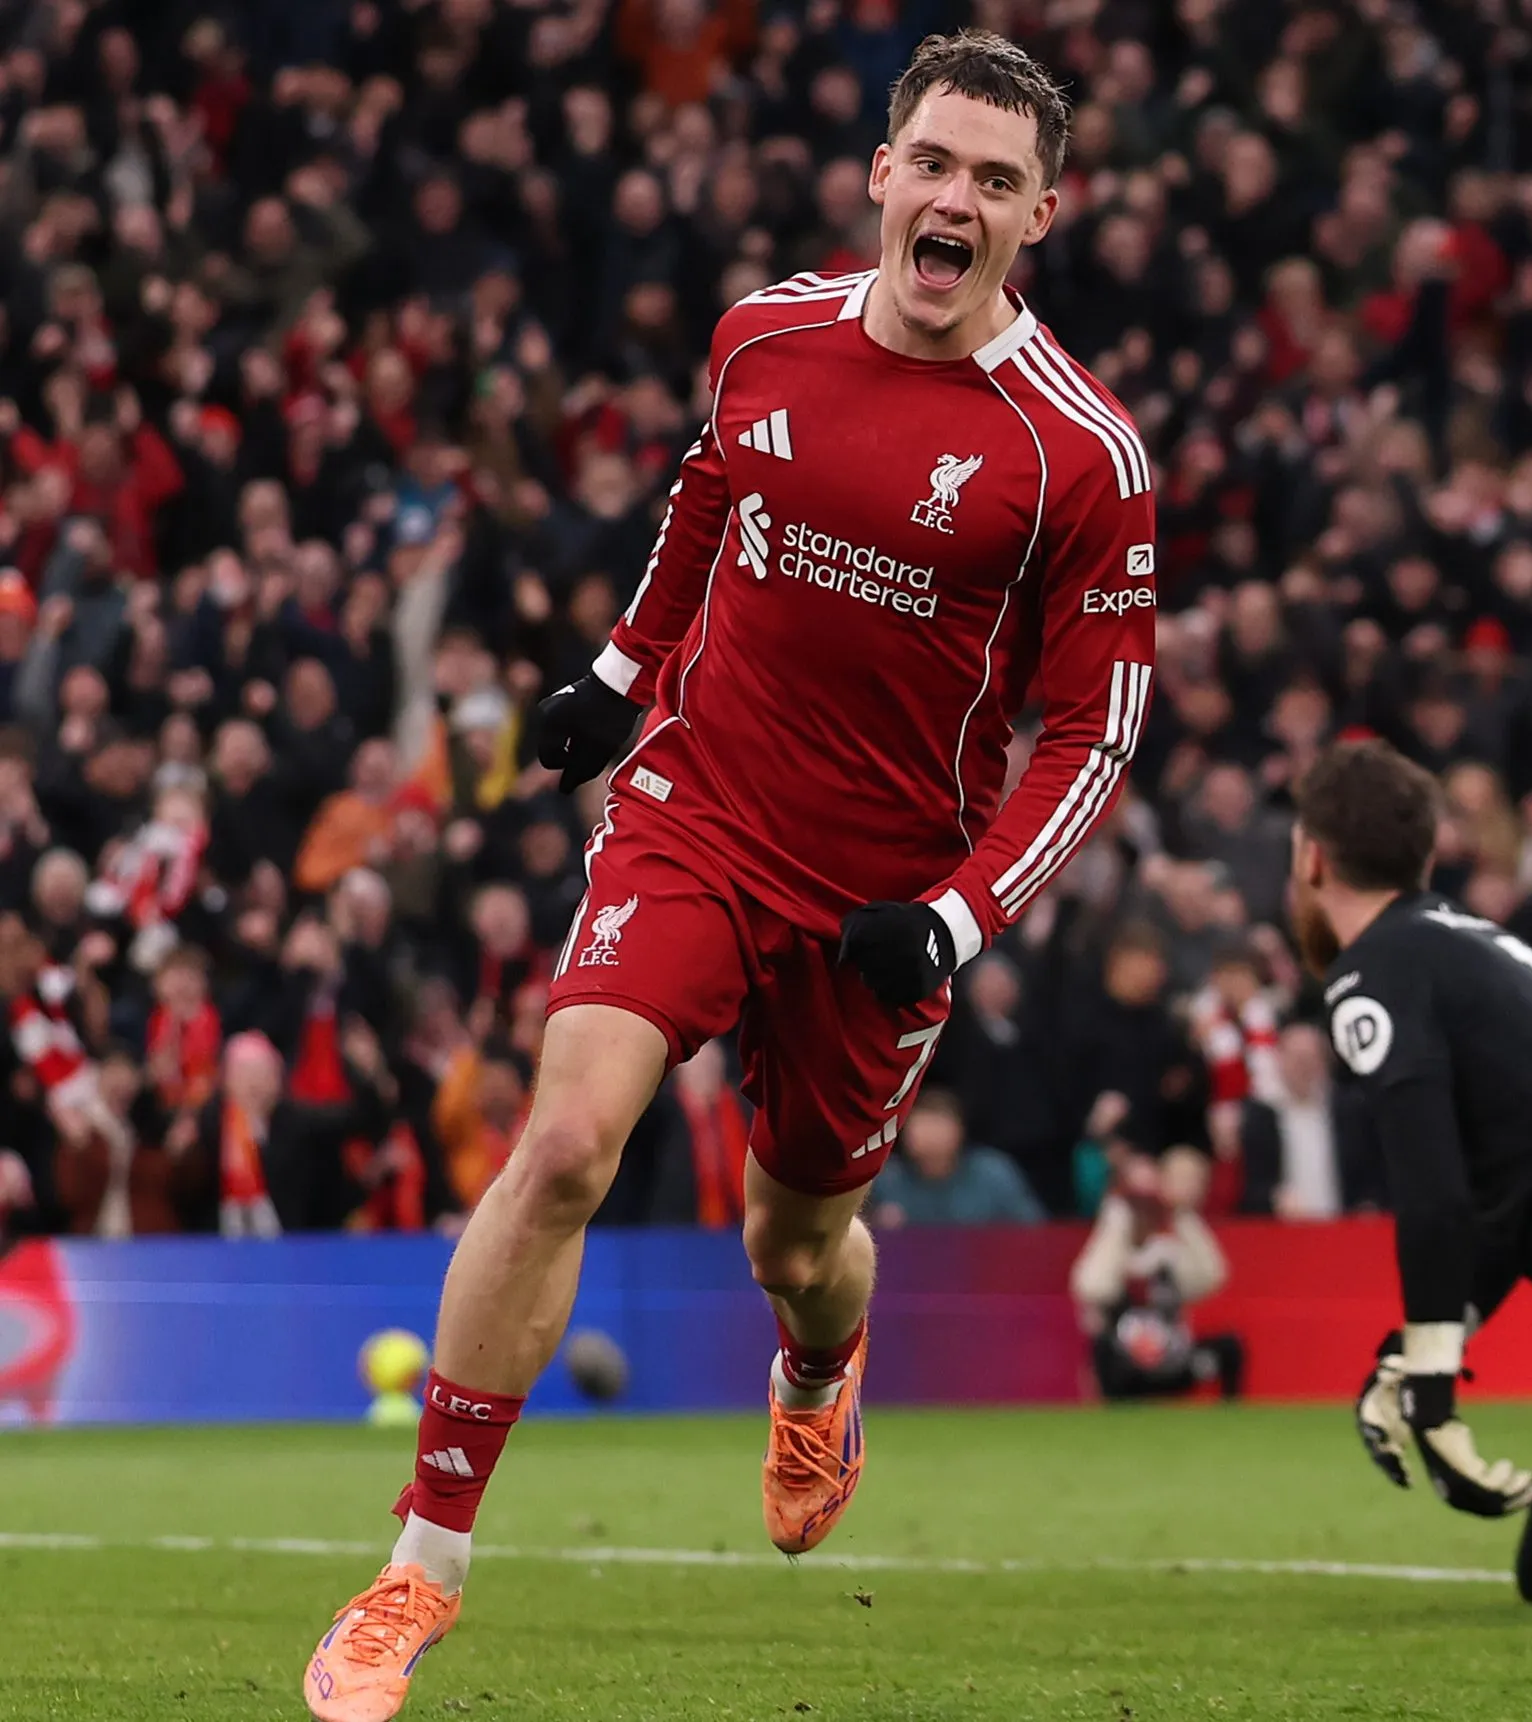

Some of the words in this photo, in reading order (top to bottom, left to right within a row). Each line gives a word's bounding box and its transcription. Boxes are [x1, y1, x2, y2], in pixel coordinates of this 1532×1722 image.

[910, 504, 954, 534] L.F.C.
[782, 522, 935, 590] standard
[779, 551, 938, 618] chartered
[1083, 587, 1157, 616] Expe
[577, 950, 619, 967] L.F.C.
[883, 1015, 949, 1111] 7
[430, 1384, 492, 1420] LFC
